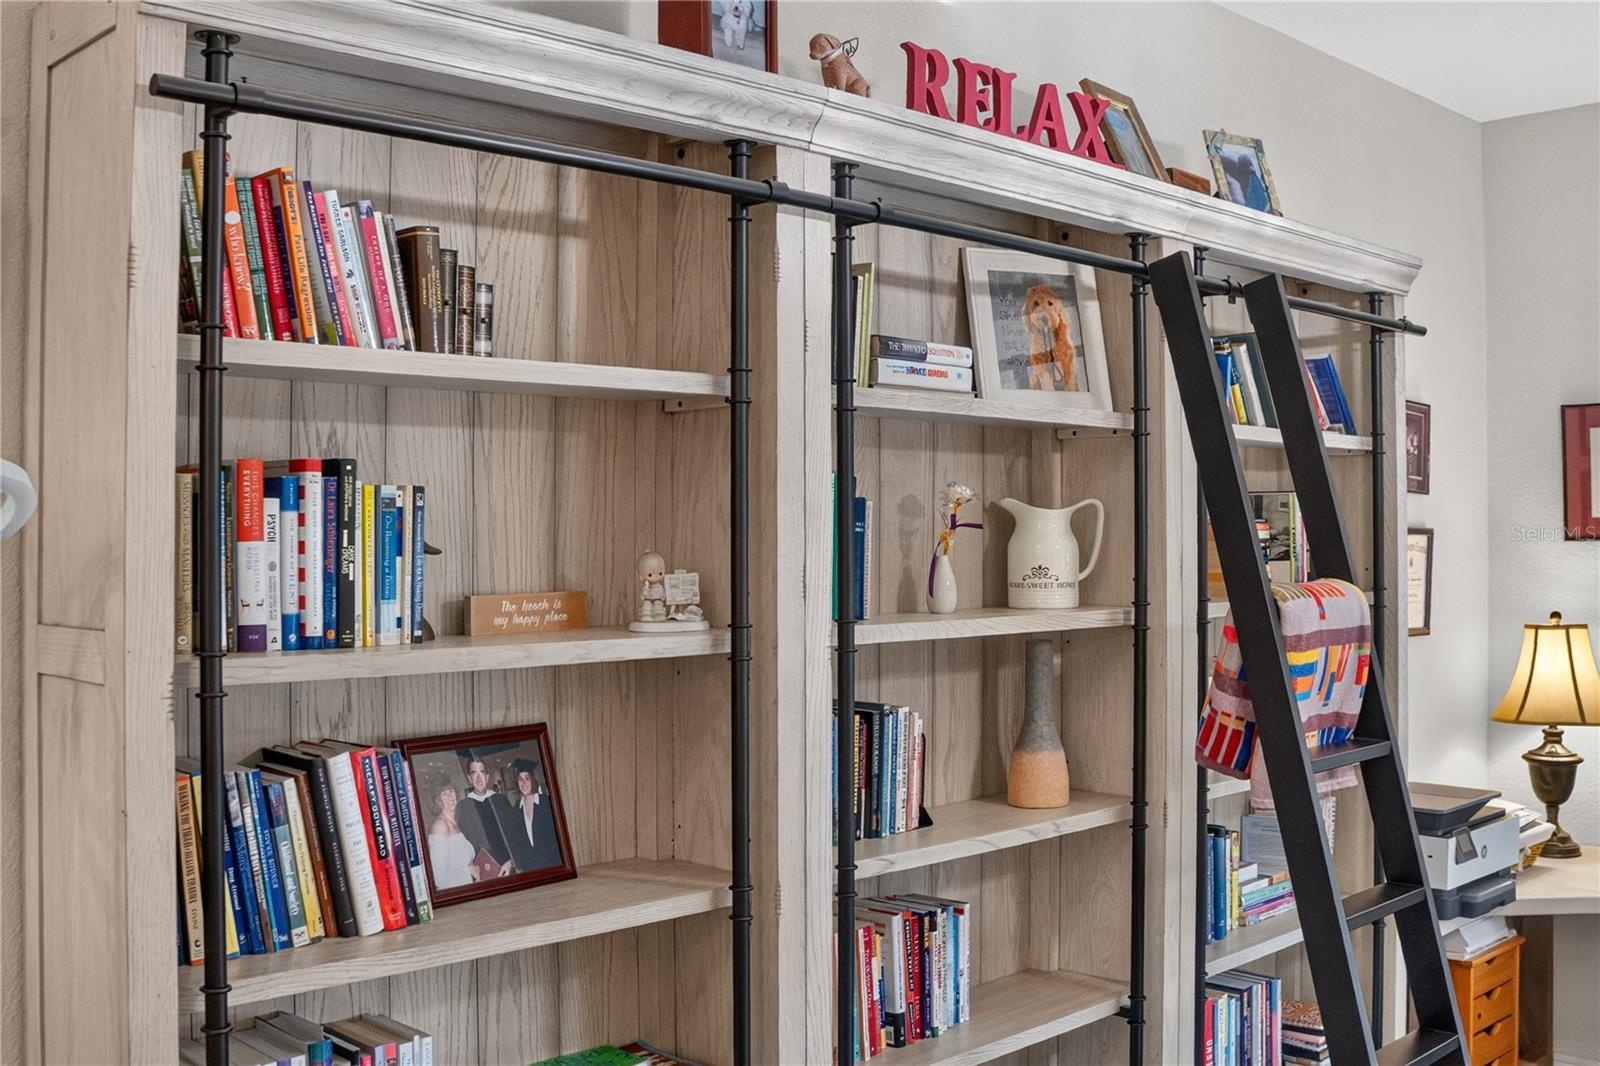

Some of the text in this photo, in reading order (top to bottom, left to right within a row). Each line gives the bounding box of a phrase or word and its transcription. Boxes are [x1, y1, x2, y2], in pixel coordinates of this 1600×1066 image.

[900, 41, 1126, 169] RELAX
[227, 225, 242, 251] who
[231, 252, 251, 292] knew?
[297, 256, 307, 273] Life
[243, 469, 251, 526] EVERYTHING
[251, 470, 259, 536] THIS CHANGES
[266, 513, 277, 544] PSYCH
[325, 482, 336, 572] Dr. Laura Schlessinger
[493, 610, 568, 629] my happy place
[501, 598, 562, 612] The beach is
[361, 757, 387, 856] THERAPY GONE MAD
